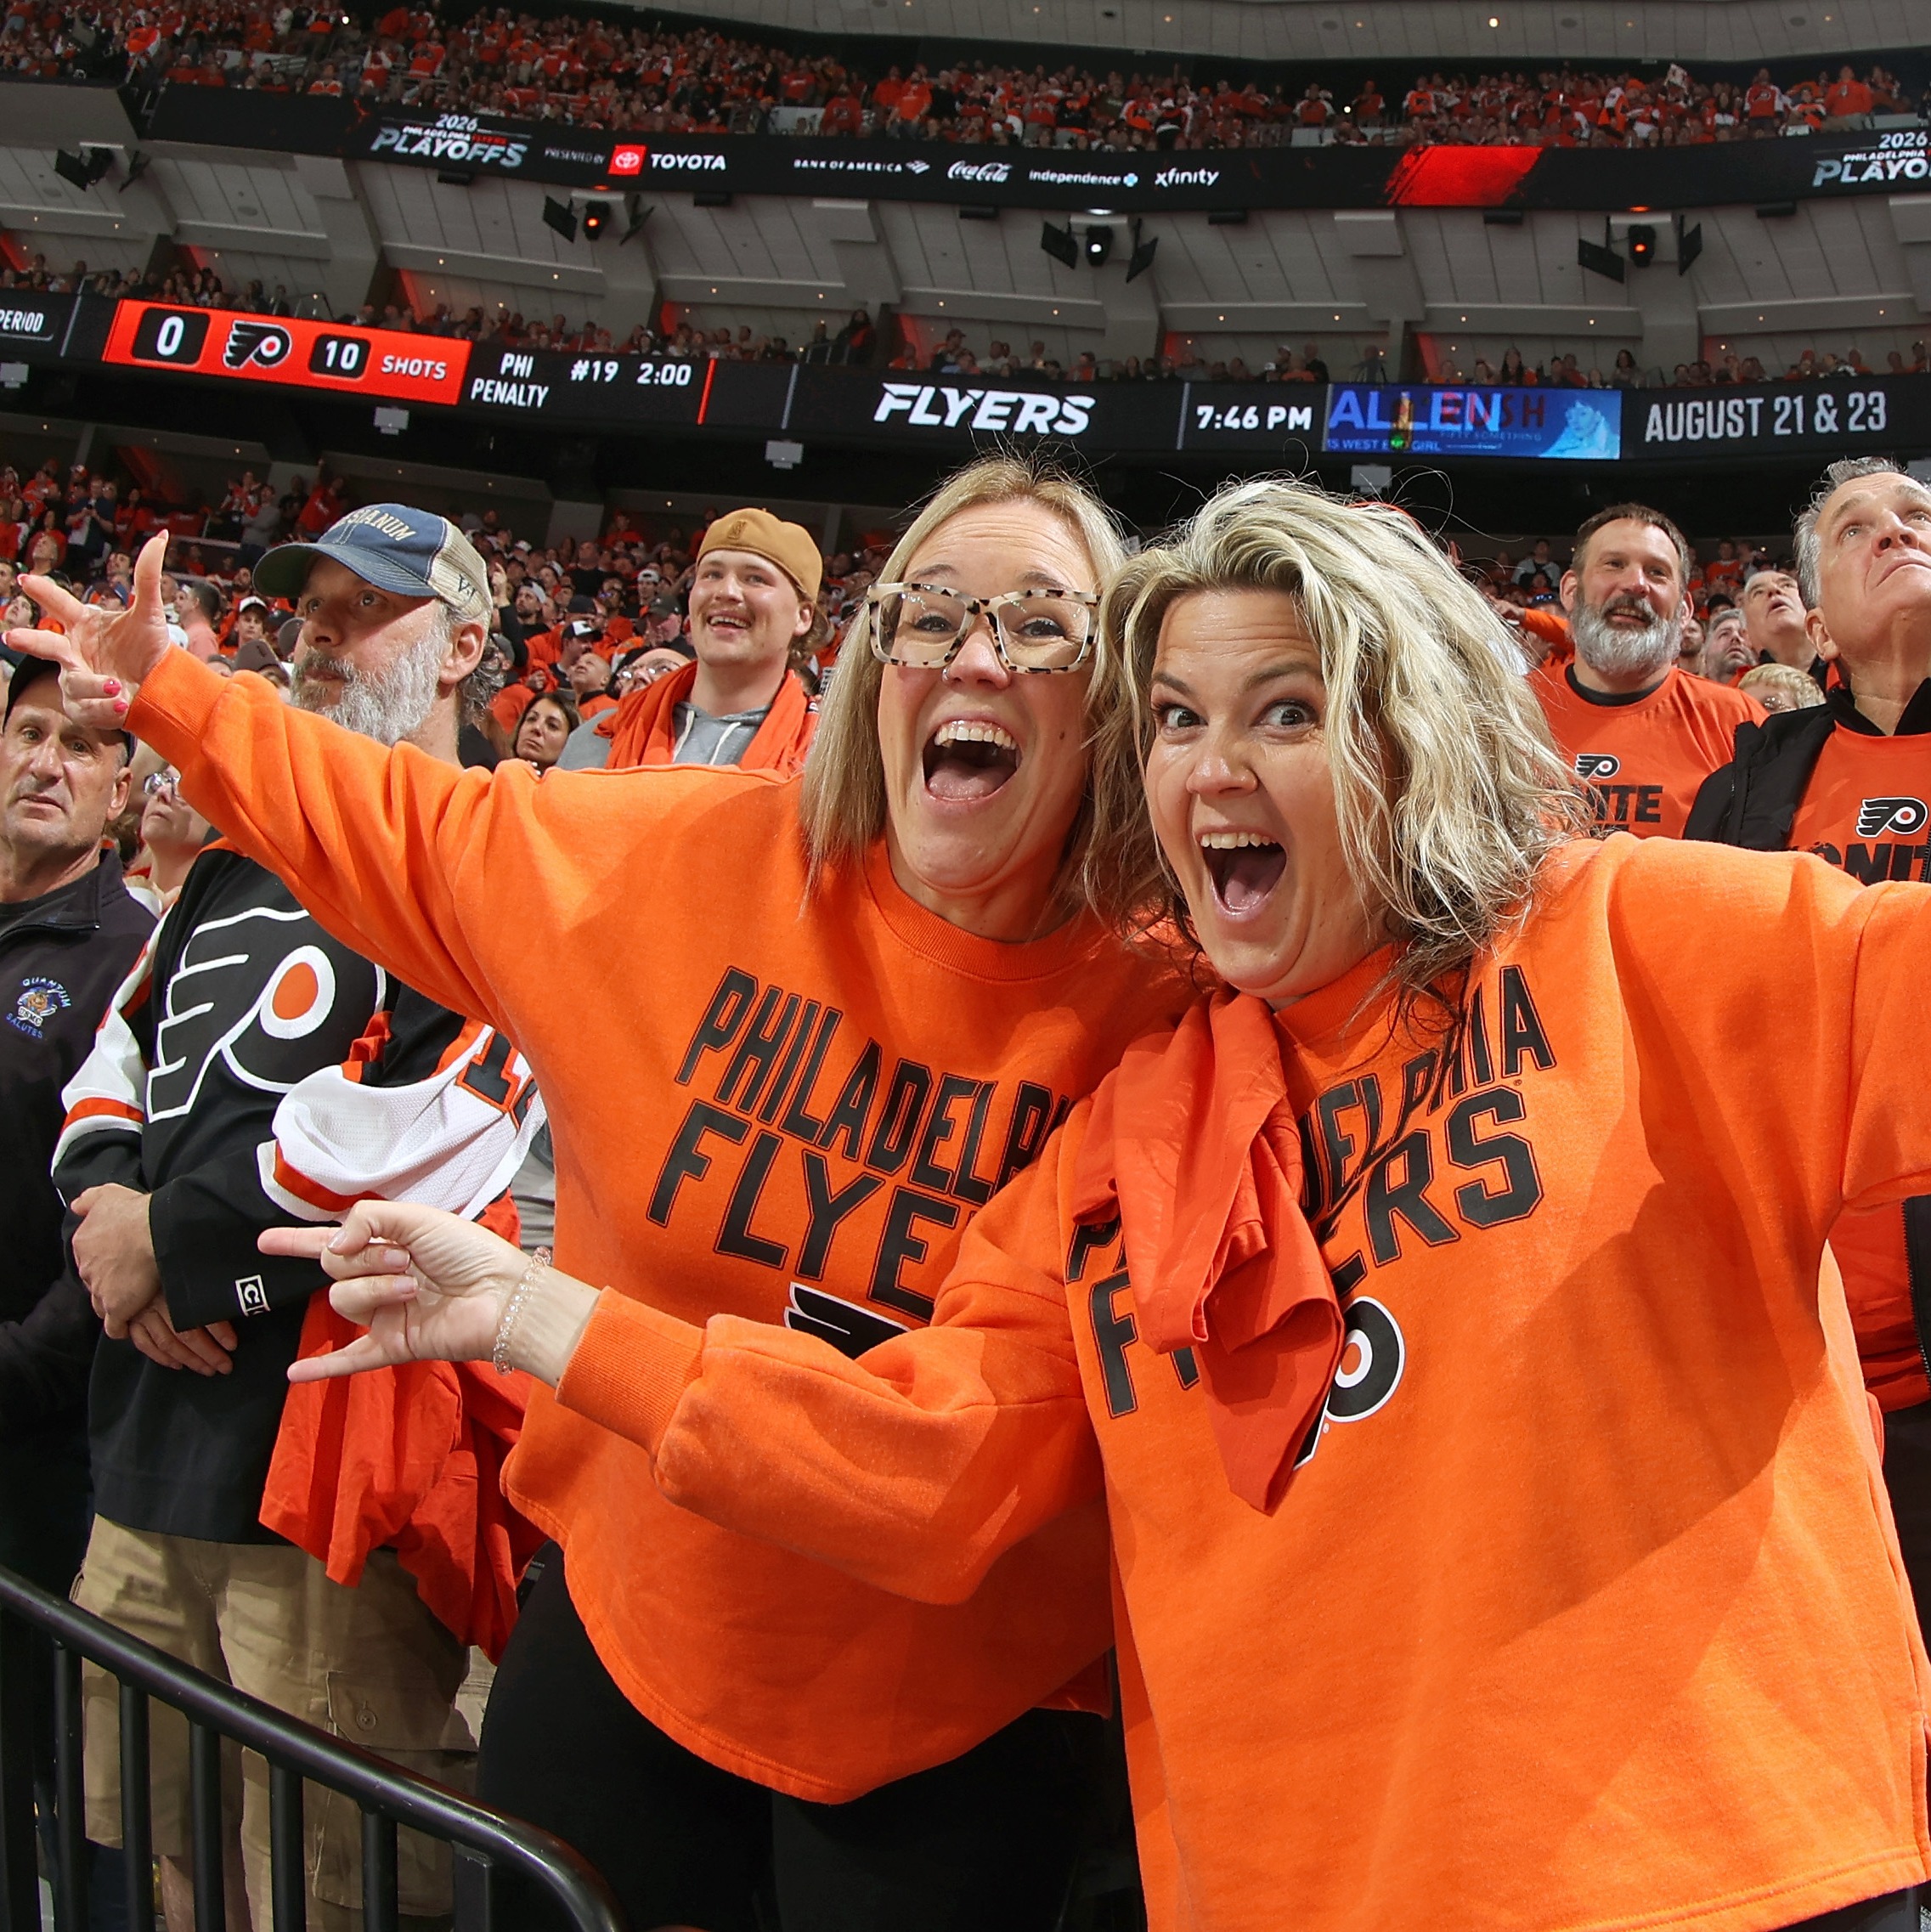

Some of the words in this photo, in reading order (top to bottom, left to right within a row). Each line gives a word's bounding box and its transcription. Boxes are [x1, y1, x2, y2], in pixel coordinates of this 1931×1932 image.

[403, 126, 471, 141] PHILADELPHIA
[435, 114, 478, 131] 2026
[370, 128, 528, 168] PLAYOFFS
[1878, 131, 1928, 150] 2026
[545, 147, 593, 163] PRESENTED
[594, 154, 606, 164] BY
[651, 154, 726, 170] TOYOTA
[793, 159, 826, 169] BANK
[829, 161, 844, 169] OF
[846, 161, 902, 172] AMERICA
[1843, 149, 1926, 162] PHILADELPHIA
[1029, 169, 1121, 186] independence
[1155, 167, 1219, 187] xfinity
[1812, 157, 1931, 187] PLAYO
[0, 309, 44, 333] PERIOD
[156, 315, 185, 357] 0
[325, 340, 360, 370] 10
[381, 354, 448, 381] SHOTS
[500, 353, 534, 378] PHI
[570, 359, 619, 382] #19
[637, 362, 692, 386] 2:00
[471, 378, 549, 408] PENALTY
[872, 382, 1097, 435] FLYERS
[1196, 405, 1259, 430] 7:46
[1267, 406, 1313, 431] PM
[1329, 390, 1502, 432] ALLEN
[1645, 398, 1764, 443] AUGUST
[1774, 395, 1804, 436] 21
[1814, 393, 1839, 434] &
[1848, 391, 1887, 432] 23
[1342, 438, 1379, 450] WEST
[1411, 440, 1442, 452] GIRL
[22, 976, 72, 1008] QUANTUM
[6, 1013, 43, 1039] SALUTES
[646, 1099, 977, 1324] FLYE
